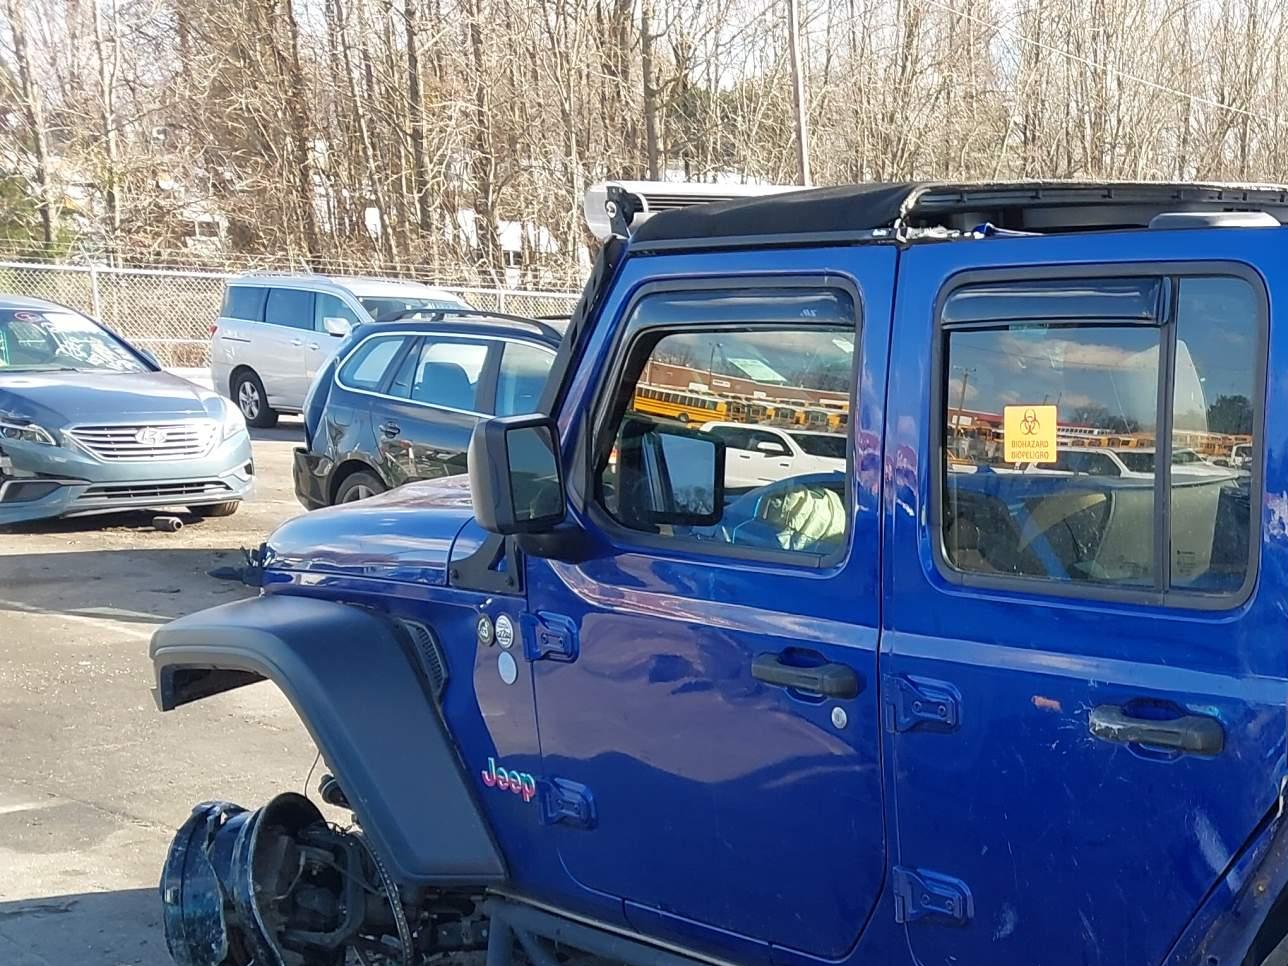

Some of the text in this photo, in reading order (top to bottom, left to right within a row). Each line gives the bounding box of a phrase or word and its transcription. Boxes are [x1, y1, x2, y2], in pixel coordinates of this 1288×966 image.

[1012, 440, 1049, 449] BIOHAZARD
[1010, 450, 1049, 460] BIOPELIGRO
[481, 756, 536, 803] Jeep
